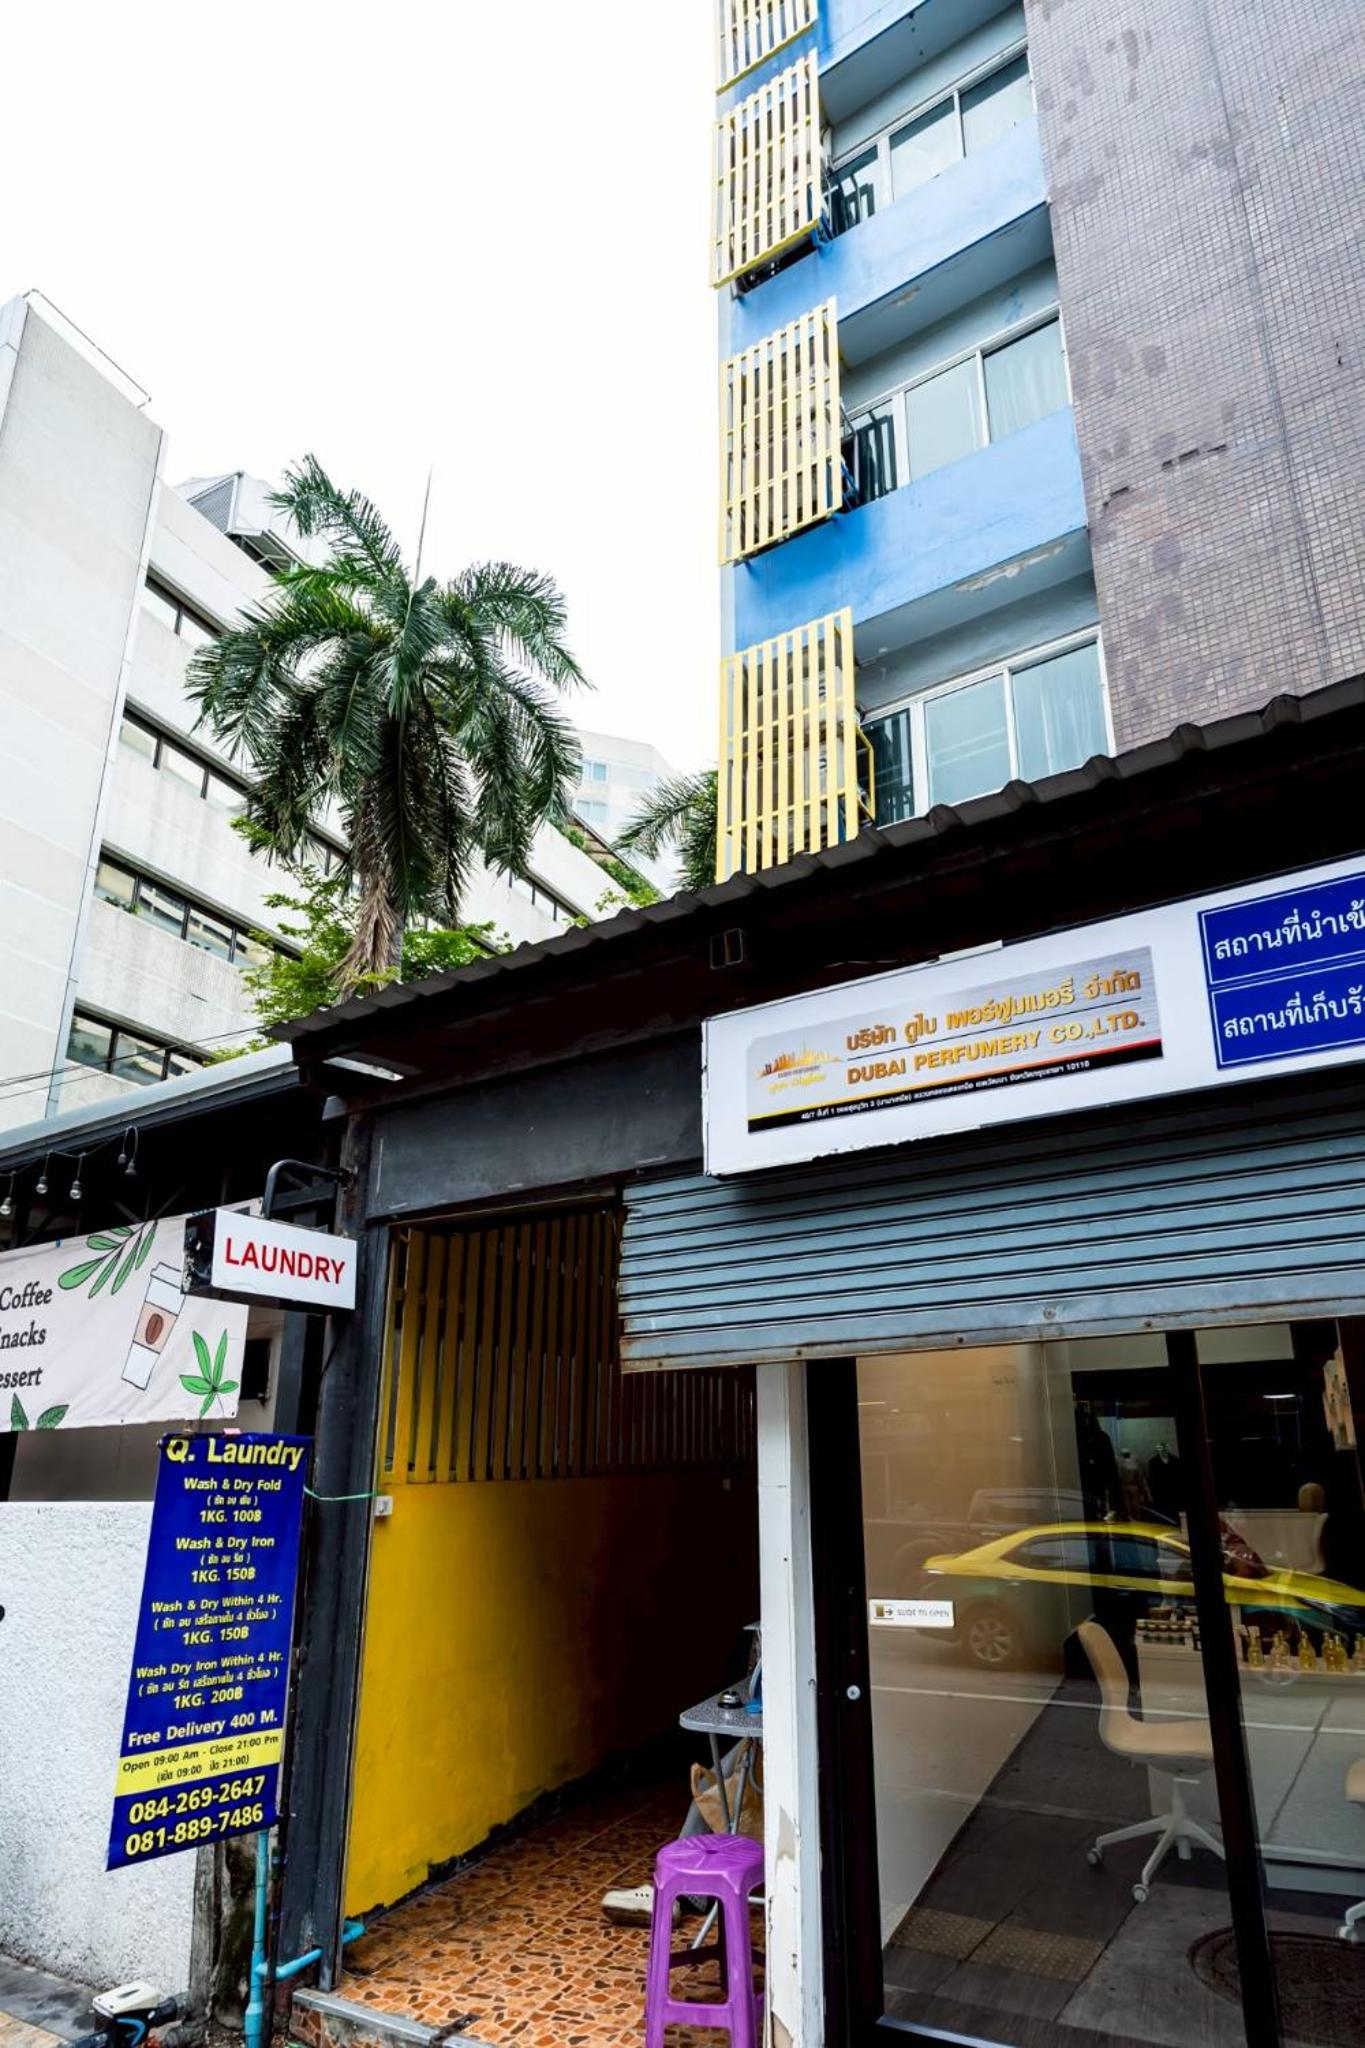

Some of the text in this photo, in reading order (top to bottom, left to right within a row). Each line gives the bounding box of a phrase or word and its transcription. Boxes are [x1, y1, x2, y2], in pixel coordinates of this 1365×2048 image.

[847, 1024, 897, 1051] บริษัท
[904, 1012, 937, 1044] ดูไบ
[1083, 969, 1141, 999] จำกัด
[1223, 985, 1365, 1038] สถานที่เก็บรั
[847, 1057, 907, 1085] DUBAI
[914, 1030, 1041, 1072] PERFUMERY
[1047, 1010, 1146, 1044] CO.,LTD.
[225, 1237, 345, 1285] LAUNDRY
[0, 1281, 53, 1311] Coffee
[0, 1320, 47, 1349] nacks
[166, 1437, 304, 1471] Q. Laundry
[184, 1477, 281, 1492] Wash & Dry Fold
[200, 1510, 228, 1523] 1KG.
[176, 1536, 275, 1550] Wash & Dry Iron
[191, 1570, 220, 1583] 1KG.
[152, 1593, 282, 1613] Wash & Dry Within 4 Hr.
[183, 1630, 213, 1645] 1KG.
[136, 1652, 283, 1678] Wash Dry Iron Within 4 Hr.
[174, 1693, 205, 1709] 1KG.
[128, 1709, 278, 1747] Free Delivery 400 M.
[122, 1759, 149, 1774] Open
[153, 1752, 180, 1766] 09:00
[183, 1750, 199, 1761] Am
[209, 1743, 234, 1755] Close
[236, 1737, 261, 1750] 21:00
[264, 1735, 279, 1745] Pm
[177, 1765, 202, 1778] 09:00
[222, 1754, 250, 1769] 21:00)
[128, 1775, 266, 1825] 084-269-2647
[125, 1803, 264, 1857] 081-889-7486
